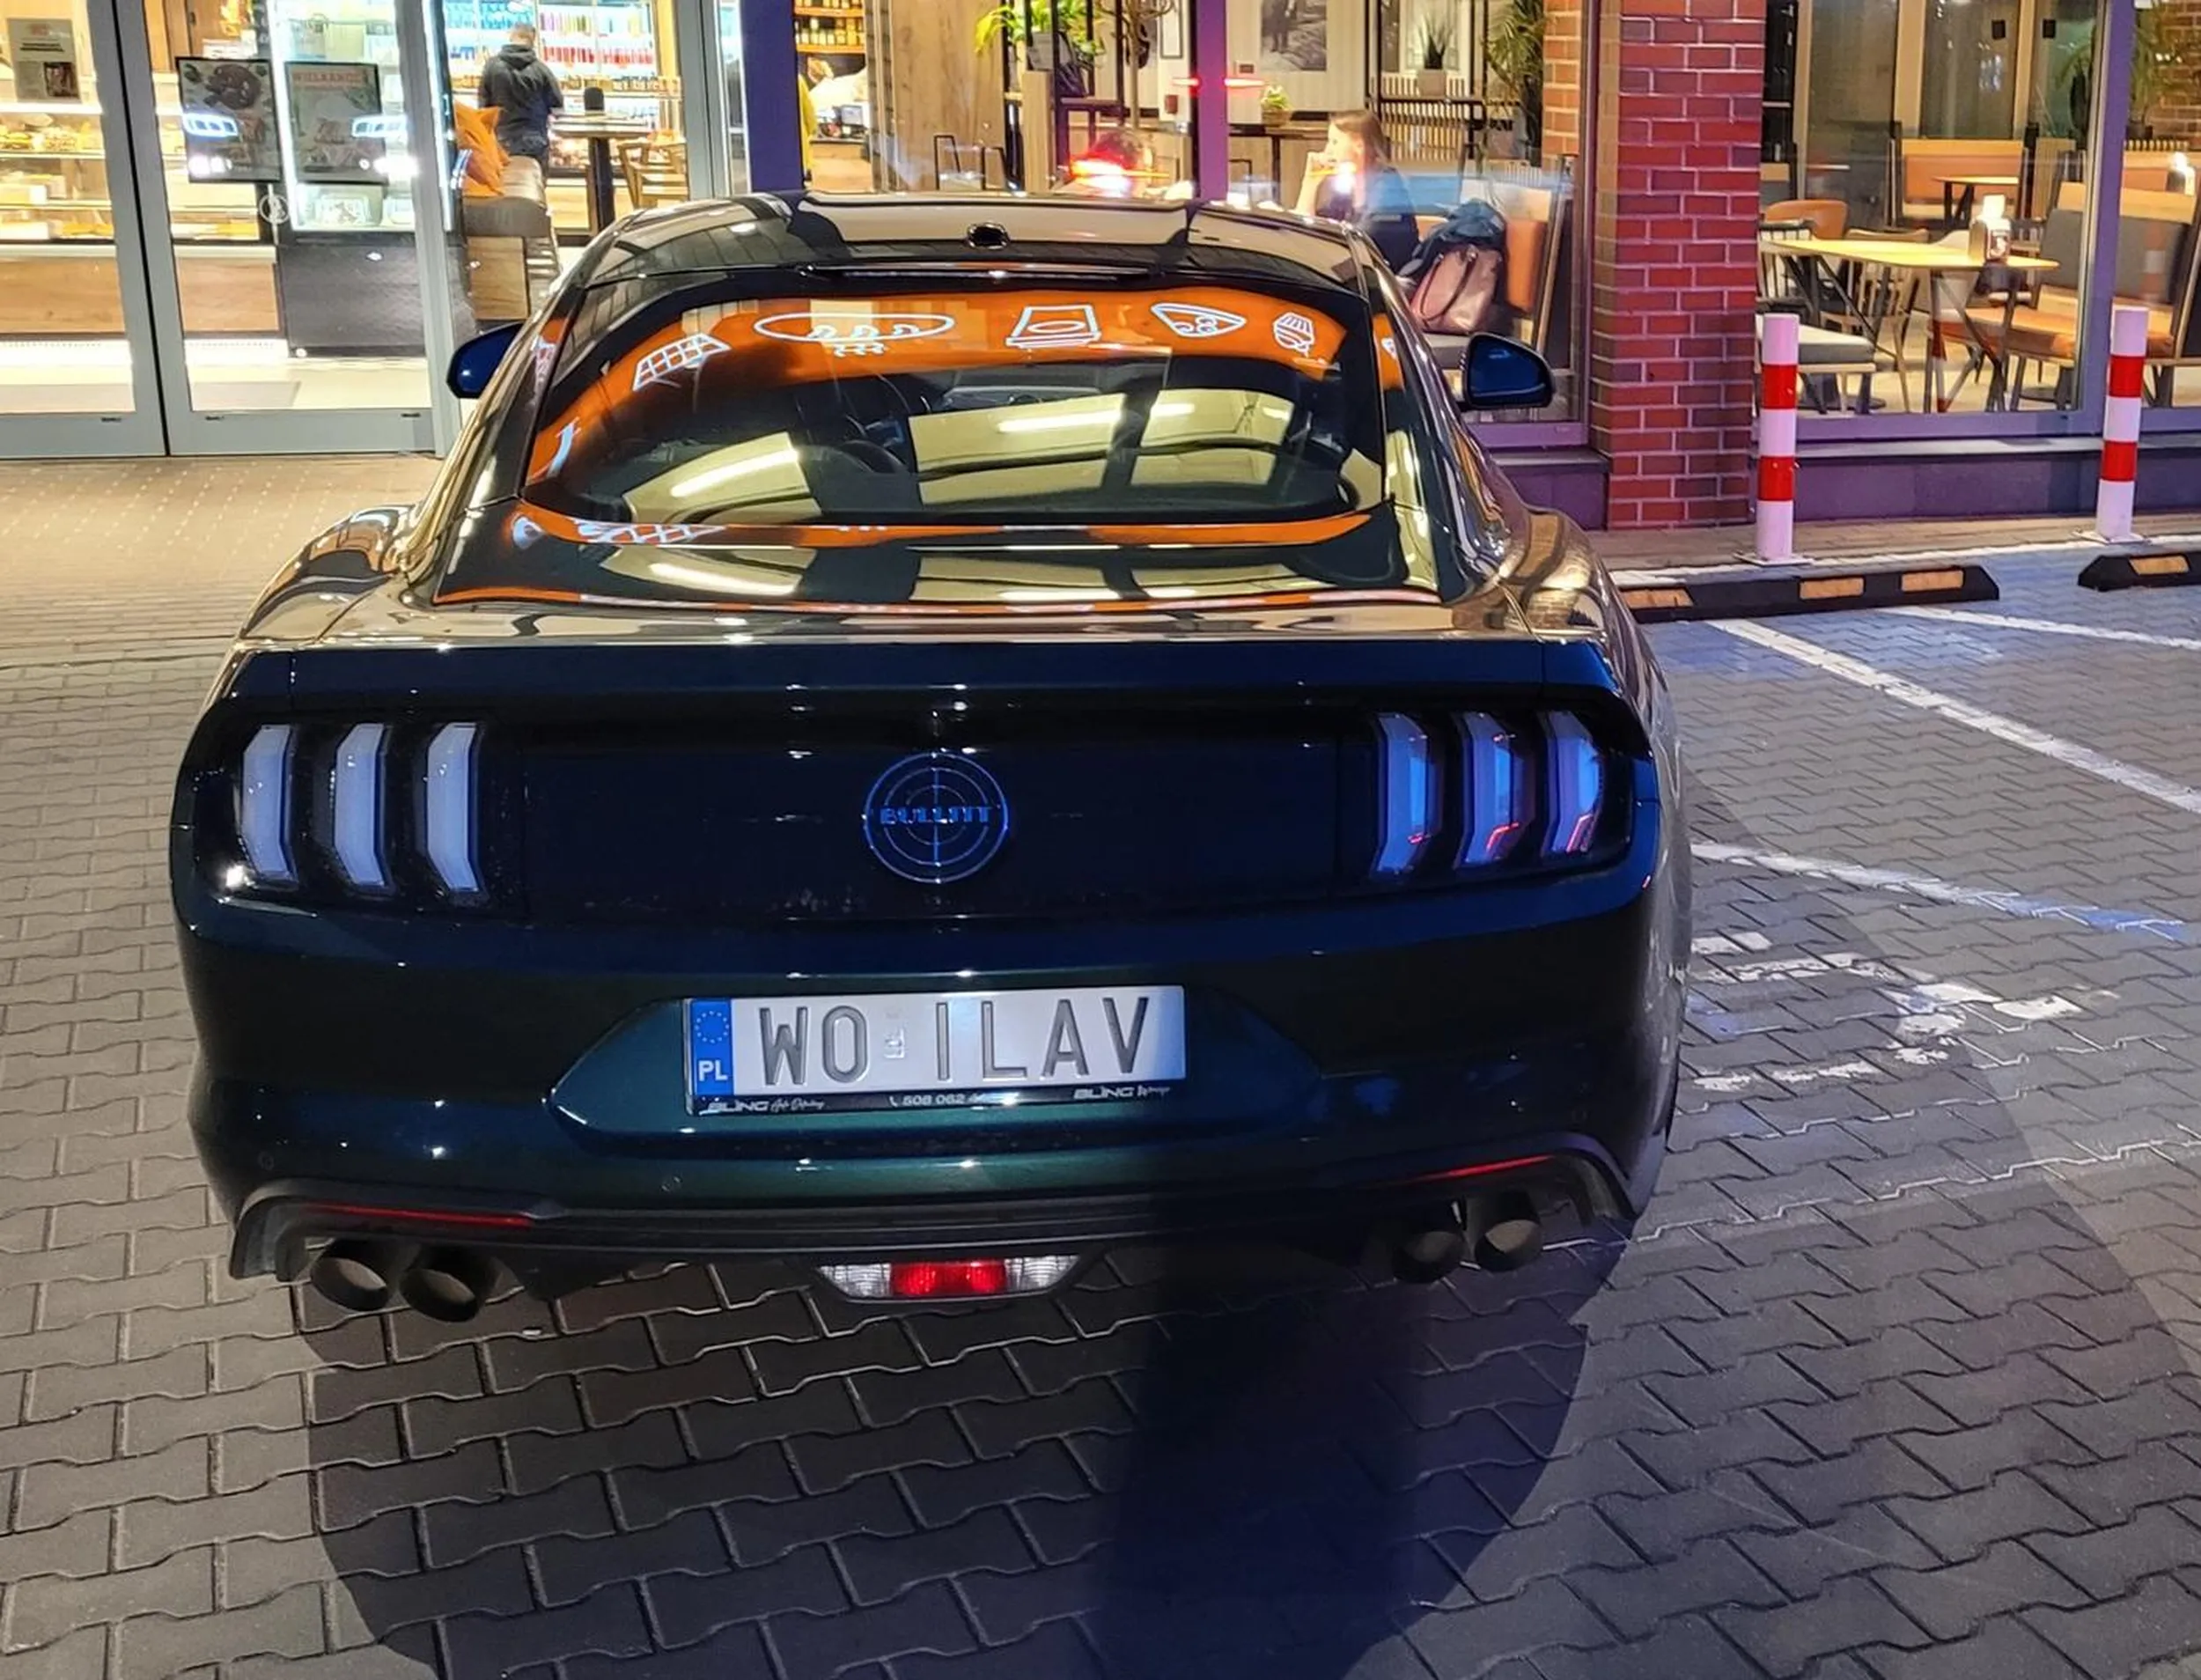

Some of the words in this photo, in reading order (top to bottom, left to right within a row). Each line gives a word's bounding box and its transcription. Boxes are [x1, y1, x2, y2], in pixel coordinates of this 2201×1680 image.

[880, 806, 991, 825] BULLITT
[698, 1059, 729, 1082] PL
[1073, 1086, 1135, 1100] BLING
[707, 1098, 769, 1113] BLING
